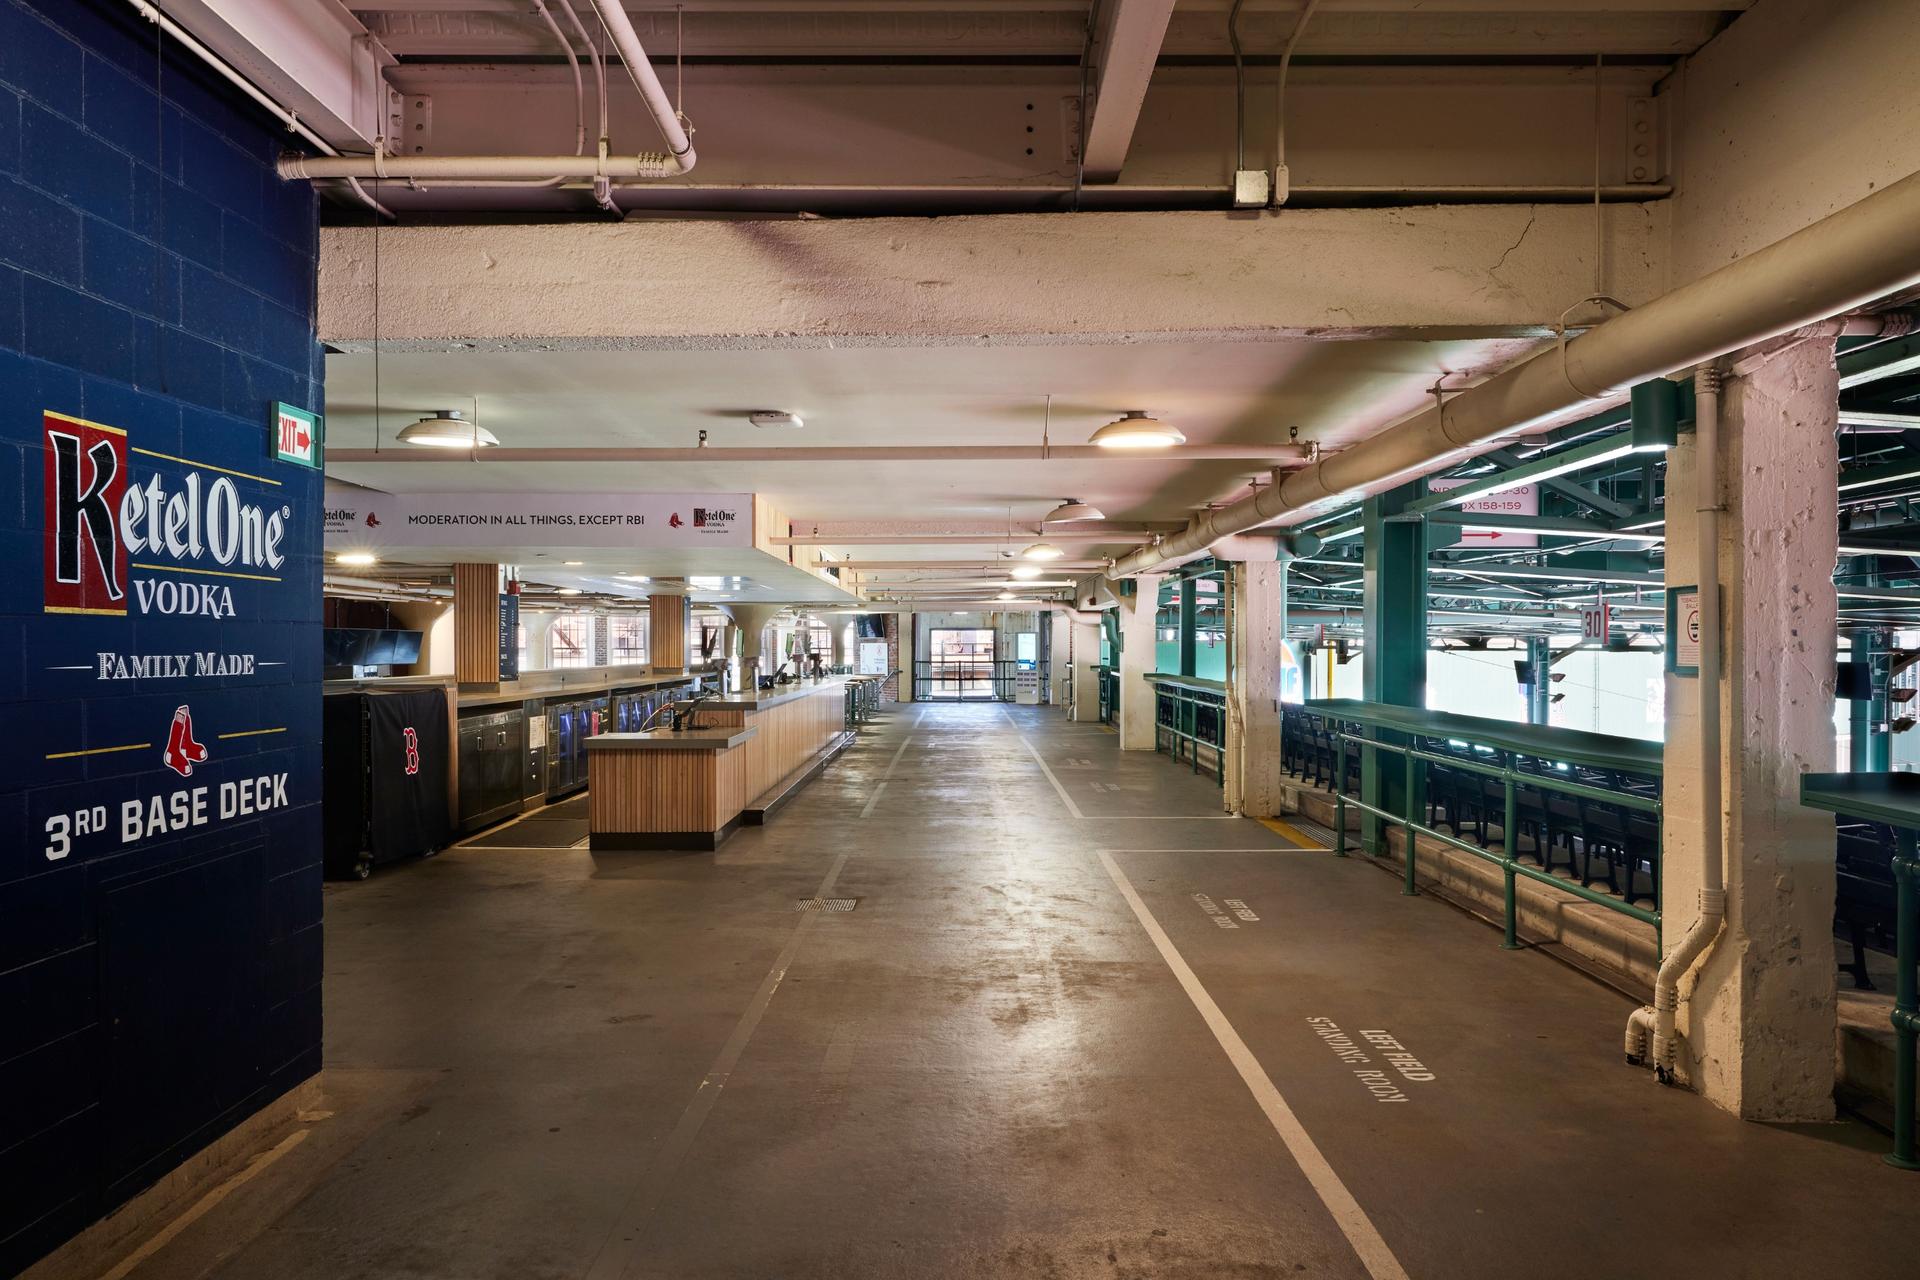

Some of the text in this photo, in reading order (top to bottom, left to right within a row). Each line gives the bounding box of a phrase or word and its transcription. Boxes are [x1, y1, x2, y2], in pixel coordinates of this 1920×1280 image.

[48, 430, 205, 601] Ketel
[408, 514, 645, 526] MODERATION IN ALL THINGS, EXCEPT RBI
[1461, 501, 1522, 510] OX 158-159
[133, 578, 237, 619] VODKA
[1585, 611, 1601, 638] 30
[97, 652, 255, 680] FAMILY MADE
[404, 727, 419, 775] B
[45, 772, 289, 861] 3RD BASE DECK
[1305, 1016, 1410, 1102] STANDING ROOM
[1359, 1029, 1436, 1081] LEFT FIELD
